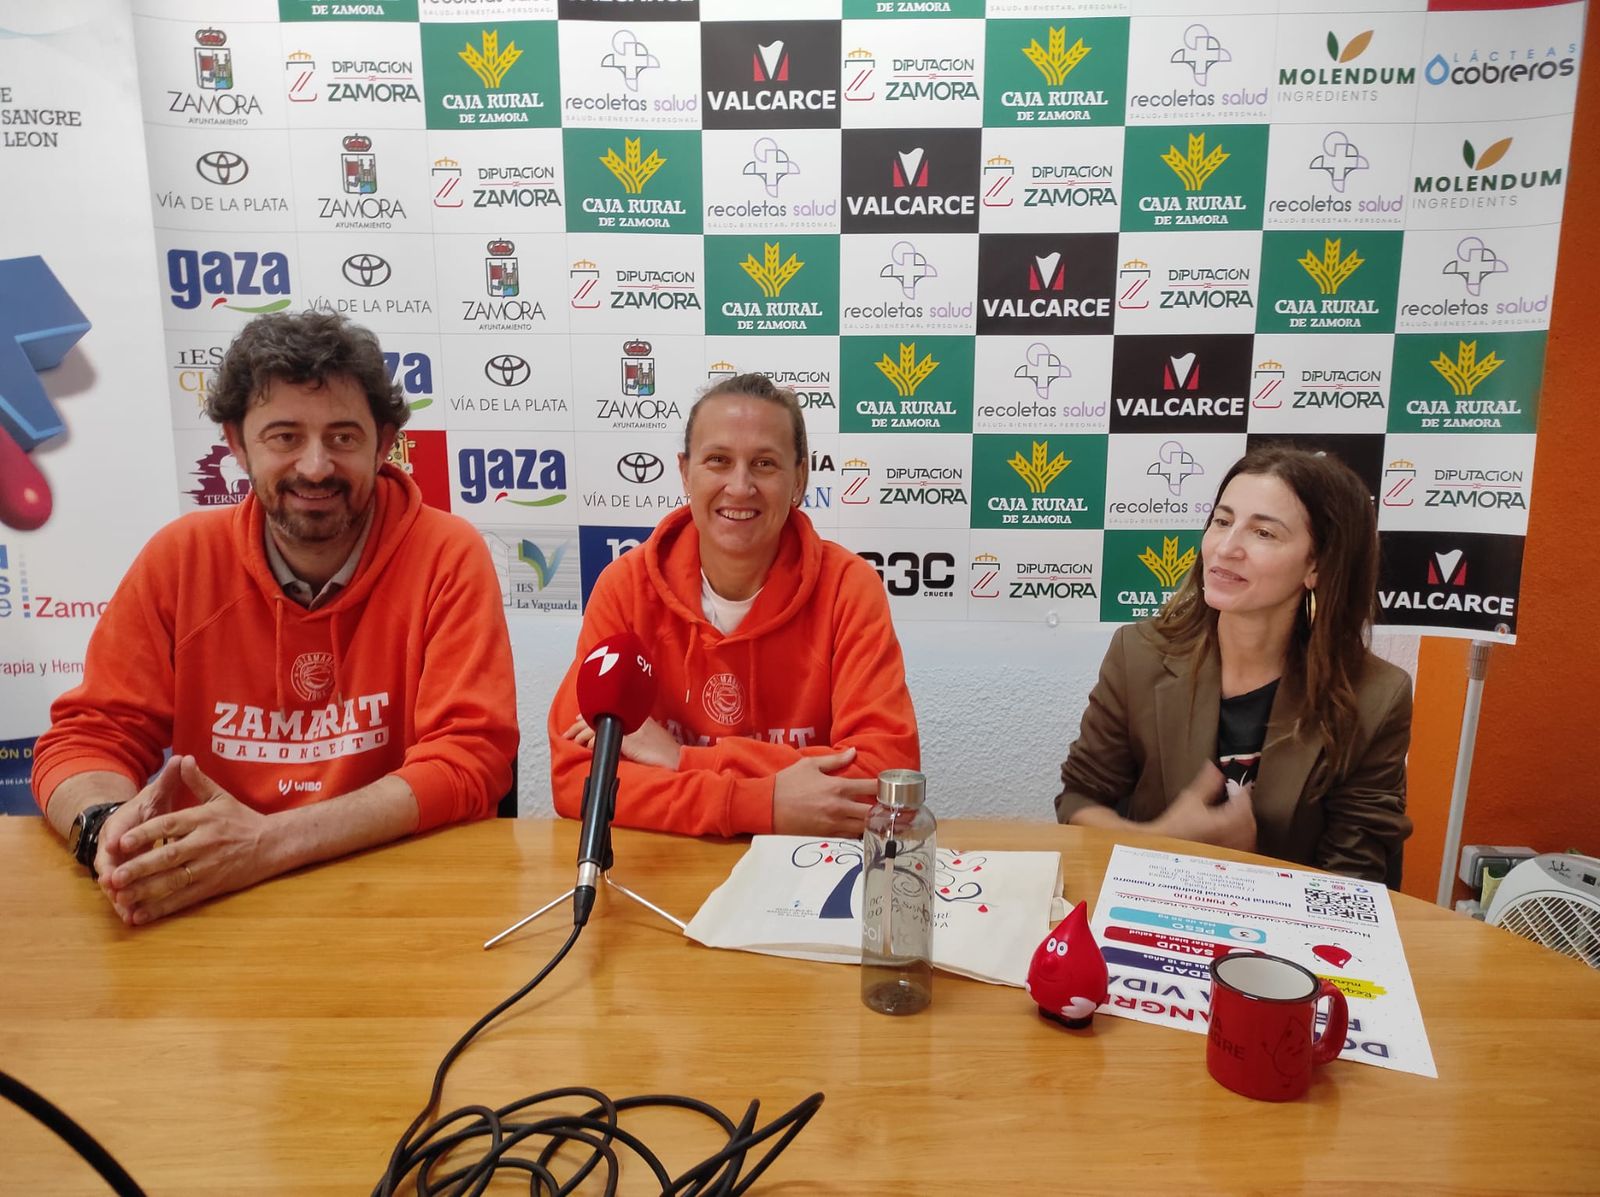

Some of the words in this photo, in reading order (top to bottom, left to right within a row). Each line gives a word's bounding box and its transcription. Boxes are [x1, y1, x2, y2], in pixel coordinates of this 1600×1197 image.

[312, 5, 329, 15] DE
[332, 4, 384, 15] ZAMORA
[876, 2, 894, 12] DE
[897, 1, 951, 12] ZAMORA
[1279, 68, 1415, 85] MOLENDUM
[1451, 58, 1575, 85] cobreros
[327, 83, 421, 102] ZAMORA
[886, 81, 980, 101] ZAMORA
[1001, 91, 1044, 108] CAJA
[1047, 90, 1108, 106] RURAL
[1131, 89, 1215, 107] recoletas
[1222, 88, 1268, 106] salud
[1278, 90, 1378, 103] INGREDIENTS
[168, 91, 263, 116] ZAMORA
[442, 94, 484, 110] CAJA
[487, 93, 544, 108] RURAL
[565, 94, 647, 112] recoletas
[654, 94, 697, 112] salud
[707, 90, 836, 110] VALCARCE
[2, 109, 82, 127] SANGRE
[188, 117, 248, 126] AYUNTAMIENTO
[459, 114, 476, 124] DE
[479, 113, 528, 123] ZAMORA
[1017, 111, 1034, 121] DE
[1038, 110, 1091, 120] ZAMORA
[4, 132, 58, 148] LEON
[1414, 168, 1562, 193] MOLENDUM
[156, 193, 185, 210] VÍA
[191, 197, 213, 211] DE
[220, 198, 240, 212] LA
[245, 198, 288, 212] PLATA
[473, 189, 561, 207] ZAMORA
[847, 195, 975, 216] VALCARCE
[1024, 188, 1118, 207] ZAMORA
[1138, 197, 1181, 212] CAJA
[1186, 196, 1246, 211] RURAL
[1269, 195, 1352, 212] recoletas
[1358, 196, 1403, 212] salud
[1412, 195, 1518, 209] INGREDIENTS
[318, 198, 406, 219] ZAMORA
[582, 198, 624, 215] CAJA
[628, 198, 686, 215] RURAL
[707, 200, 787, 217] recoletas
[793, 200, 836, 217] salud
[599, 217, 616, 227] DE
[619, 217, 670, 228] ZAMORA
[1154, 216, 1172, 226] DE
[1175, 215, 1228, 225] ZAMORA
[167, 249, 291, 310] gaza
[308, 296, 332, 312] VÍA
[338, 300, 357, 312] DE
[364, 300, 381, 313] LA
[387, 300, 432, 313] PLATA
[611, 291, 701, 310] ZAMORA
[982, 298, 1110, 317] VALCARCE
[1160, 290, 1254, 309] ZAMORA
[1275, 300, 1317, 315] CAJA
[1320, 300, 1379, 314] RURAL
[1401, 299, 1488, 316] recoletas
[1496, 295, 1548, 314] salud
[462, 301, 546, 321] ZAMORA
[722, 302, 762, 317] CAJA
[766, 302, 822, 316] RURAL
[844, 302, 923, 319] recoletas
[929, 302, 973, 318] salud
[737, 321, 754, 330] DE
[757, 320, 807, 330] ZAMORA
[1290, 318, 1307, 328] DE
[1310, 318, 1361, 328] ZAMORA
[450, 396, 475, 411] VÍA
[480, 399, 498, 411] DE
[504, 399, 521, 411] LA
[525, 399, 567, 412] PLATA
[856, 401, 897, 416] CAJA
[900, 401, 957, 415] RURAL
[1116, 397, 1245, 416] VALCARCE
[1292, 391, 1385, 409] ZAMORA
[1406, 400, 1450, 415] CAJA
[1454, 400, 1522, 415] RURAL
[597, 400, 681, 419] ZAMORA
[978, 402, 1056, 418] recoletas
[1062, 402, 1106, 417] salud
[871, 419, 888, 428] DE
[891, 418, 940, 428] ZAMORA
[1421, 419, 1439, 428] DE
[1443, 418, 1501, 428] ZAMORA
[458, 448, 567, 504] gaza
[583, 492, 606, 507] VÍA
[611, 495, 630, 507] DE
[635, 495, 652, 508] LA
[658, 495, 691, 508] PLAT
[879, 487, 968, 505] ZAMORA
[987, 497, 1027, 512] CAJA
[1032, 497, 1088, 511] RURAL
[1424, 489, 1527, 510] ZAMORA
[1109, 498, 1188, 513] recoletas
[1002, 515, 1019, 524] DE
[1022, 514, 1072, 524] ZAMORA
[516, 583, 534, 592] IES
[1009, 582, 1097, 599] ZAMORA
[517, 600, 529, 609] La
[530, 599, 578, 612] Vaguada
[1117, 591, 1158, 605] CAJA
[1378, 591, 1515, 617] VALCARCE
[35, 597, 109, 618] Zamo
[1132, 608, 1149, 617] DE
[216, 732, 385, 759] BALONCESTO
[1172, 923, 1215, 935] PESO
[1156, 941, 1215, 956] SALUD
